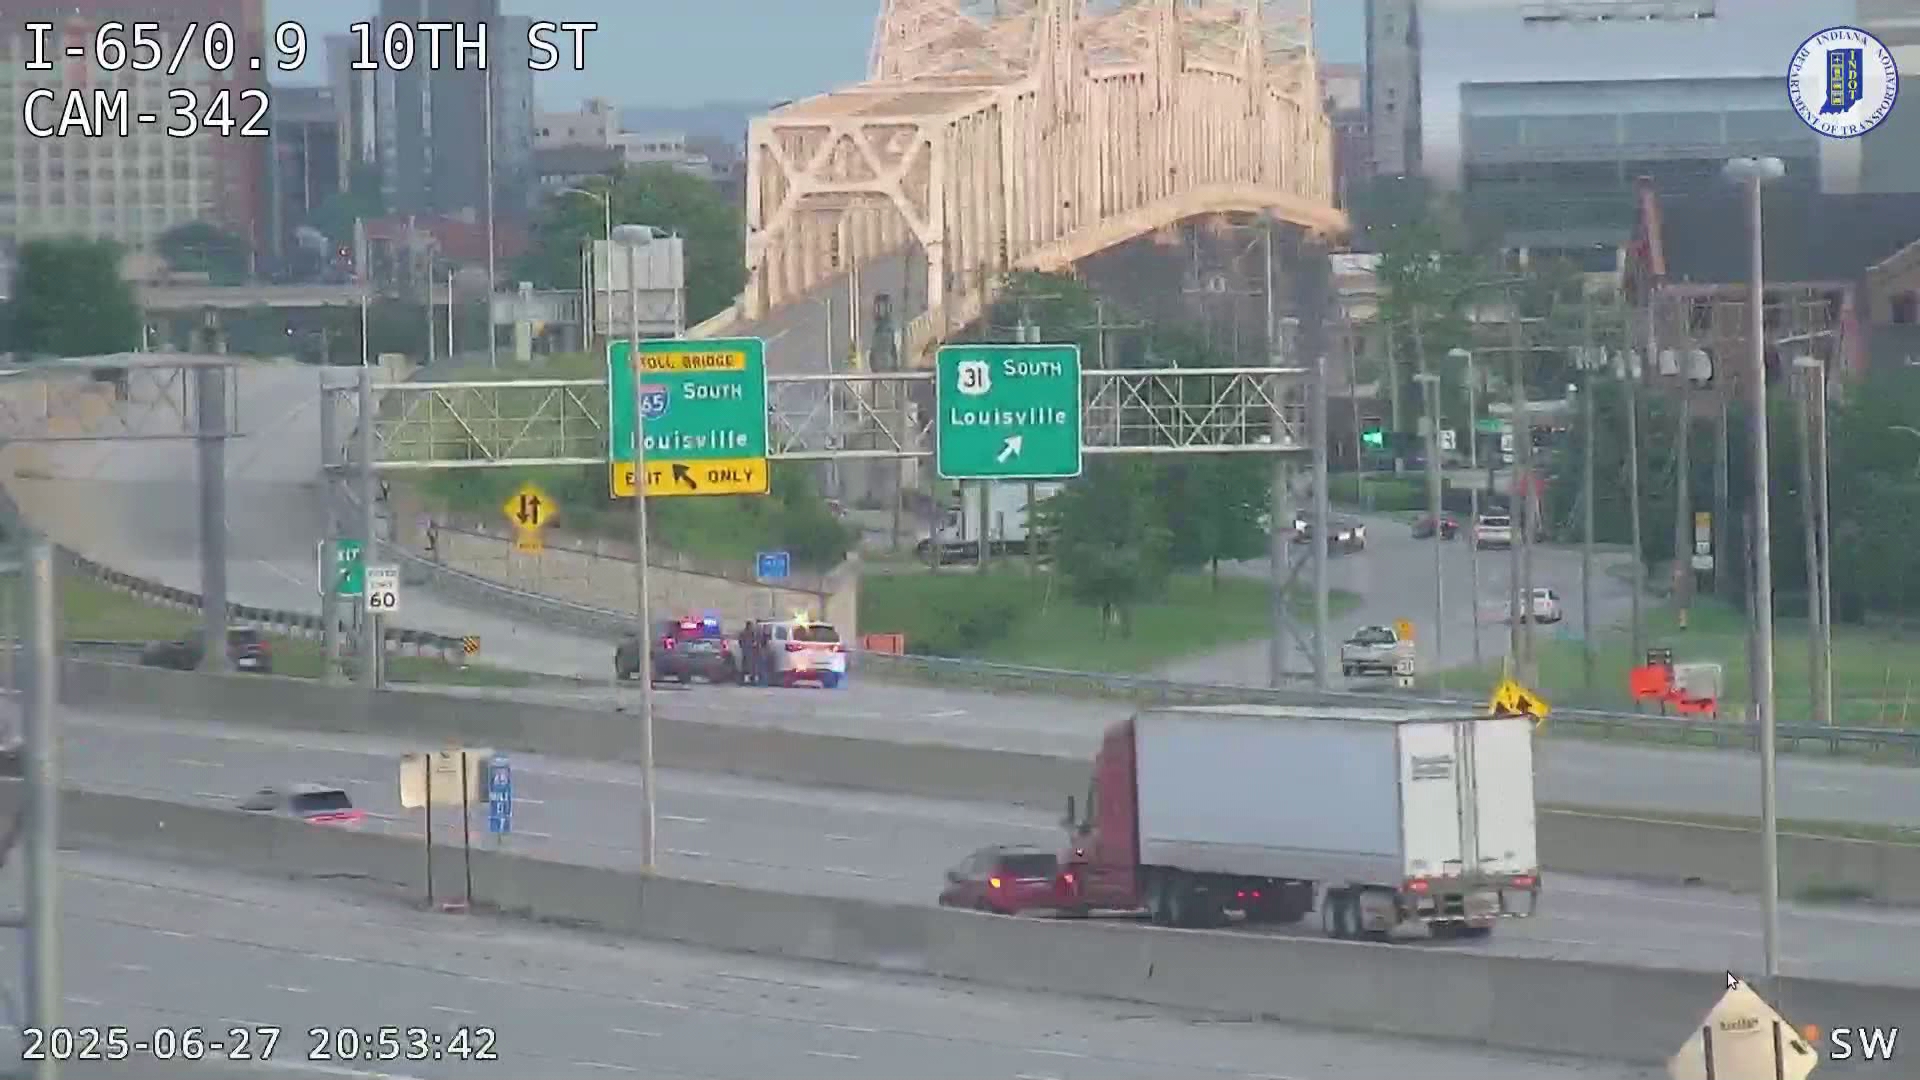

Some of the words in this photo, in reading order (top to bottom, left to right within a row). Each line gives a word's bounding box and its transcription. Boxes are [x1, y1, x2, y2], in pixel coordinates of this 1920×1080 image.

[681, 354, 735, 369] BRIDGE
[963, 367, 983, 388] 31
[640, 394, 665, 414] 65
[951, 407, 1067, 426] Louisville
[625, 472, 663, 486] EIT
[707, 467, 753, 483] ONLY
[370, 592, 396, 608] 60
